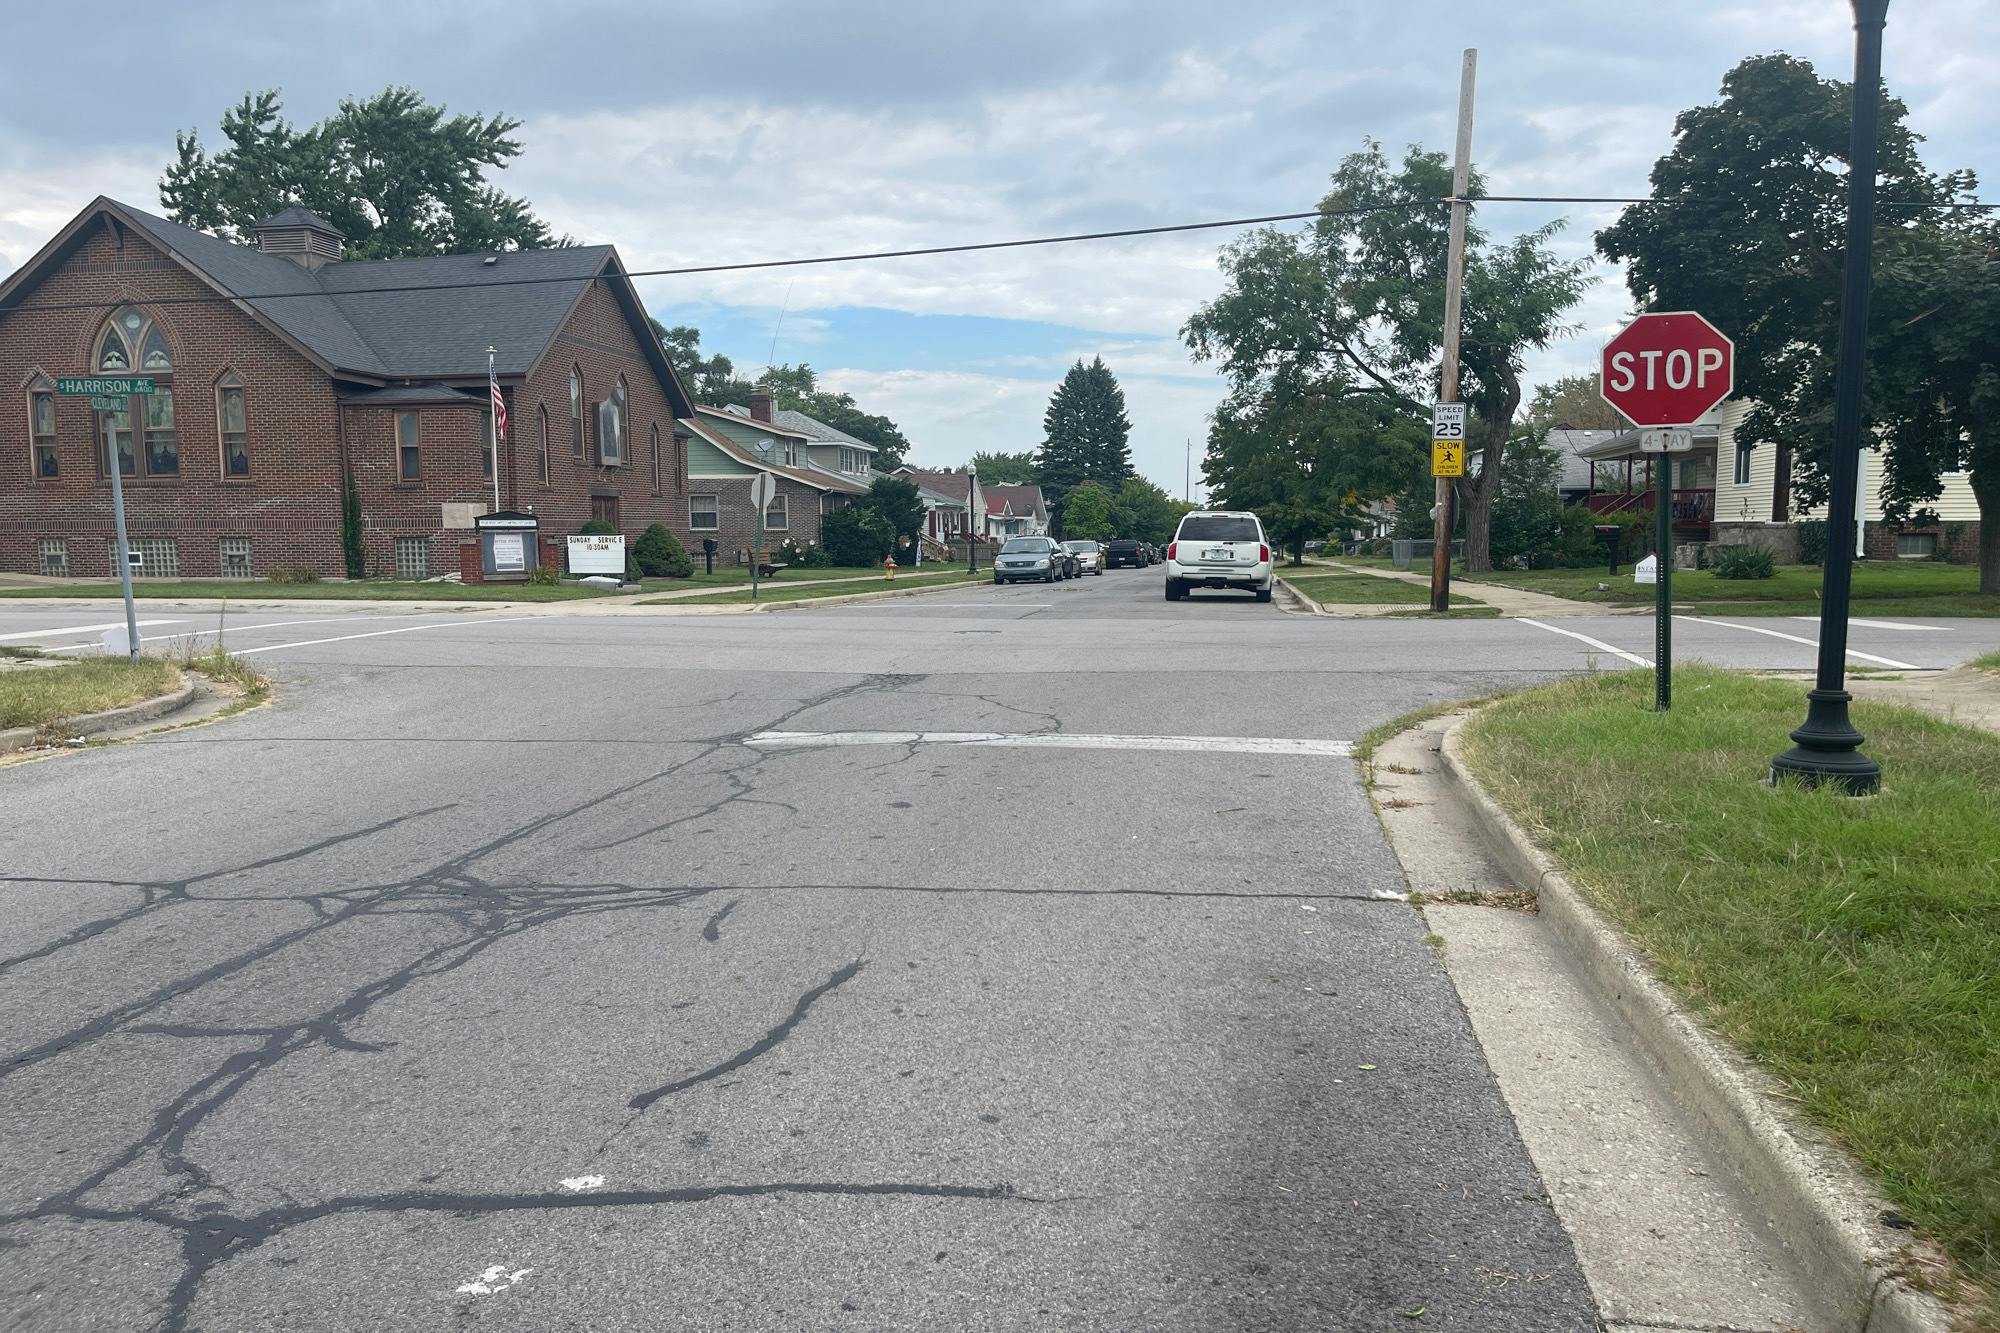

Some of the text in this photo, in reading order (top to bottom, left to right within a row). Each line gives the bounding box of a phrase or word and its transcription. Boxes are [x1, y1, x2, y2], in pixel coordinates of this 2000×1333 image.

[1610, 348, 1723, 392] STOP
[65, 380, 131, 393] HARRISON
[1436, 422, 1462, 437] 25
[1436, 442, 1460, 450] SLOW
[1643, 433, 1688, 448] 4-WAY
[569, 536, 591, 544] SUNDAY
